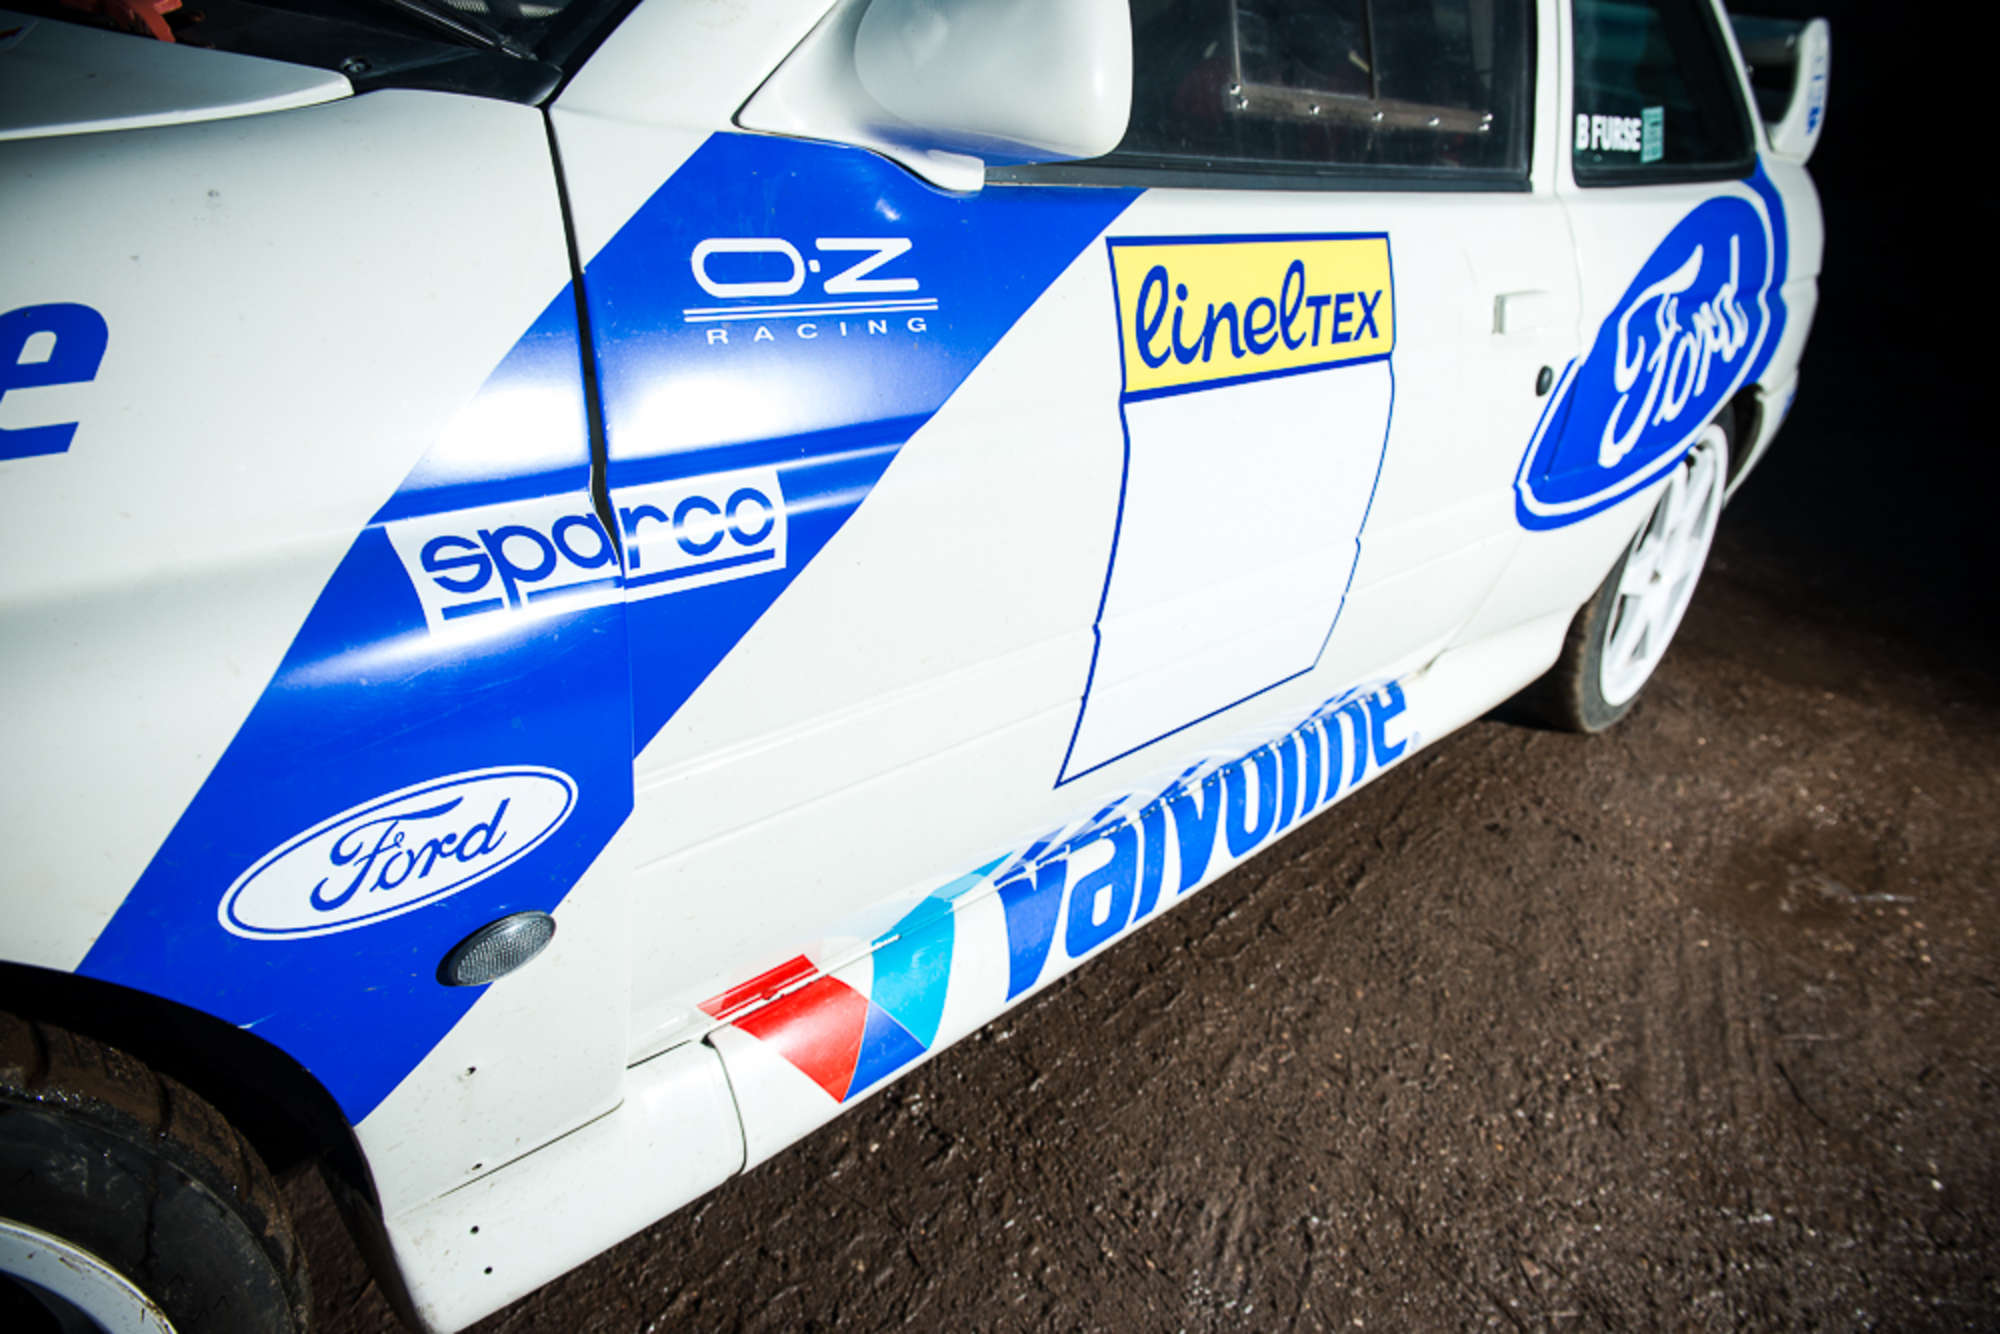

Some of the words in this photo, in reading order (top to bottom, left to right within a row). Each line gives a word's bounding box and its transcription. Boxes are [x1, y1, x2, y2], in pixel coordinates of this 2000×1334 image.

[1576, 113, 1590, 151] B
[706, 318, 928, 345] RACING
[1598, 233, 1749, 468] Ford
[420, 487, 776, 611] sparco
[309, 796, 511, 912] Ford
